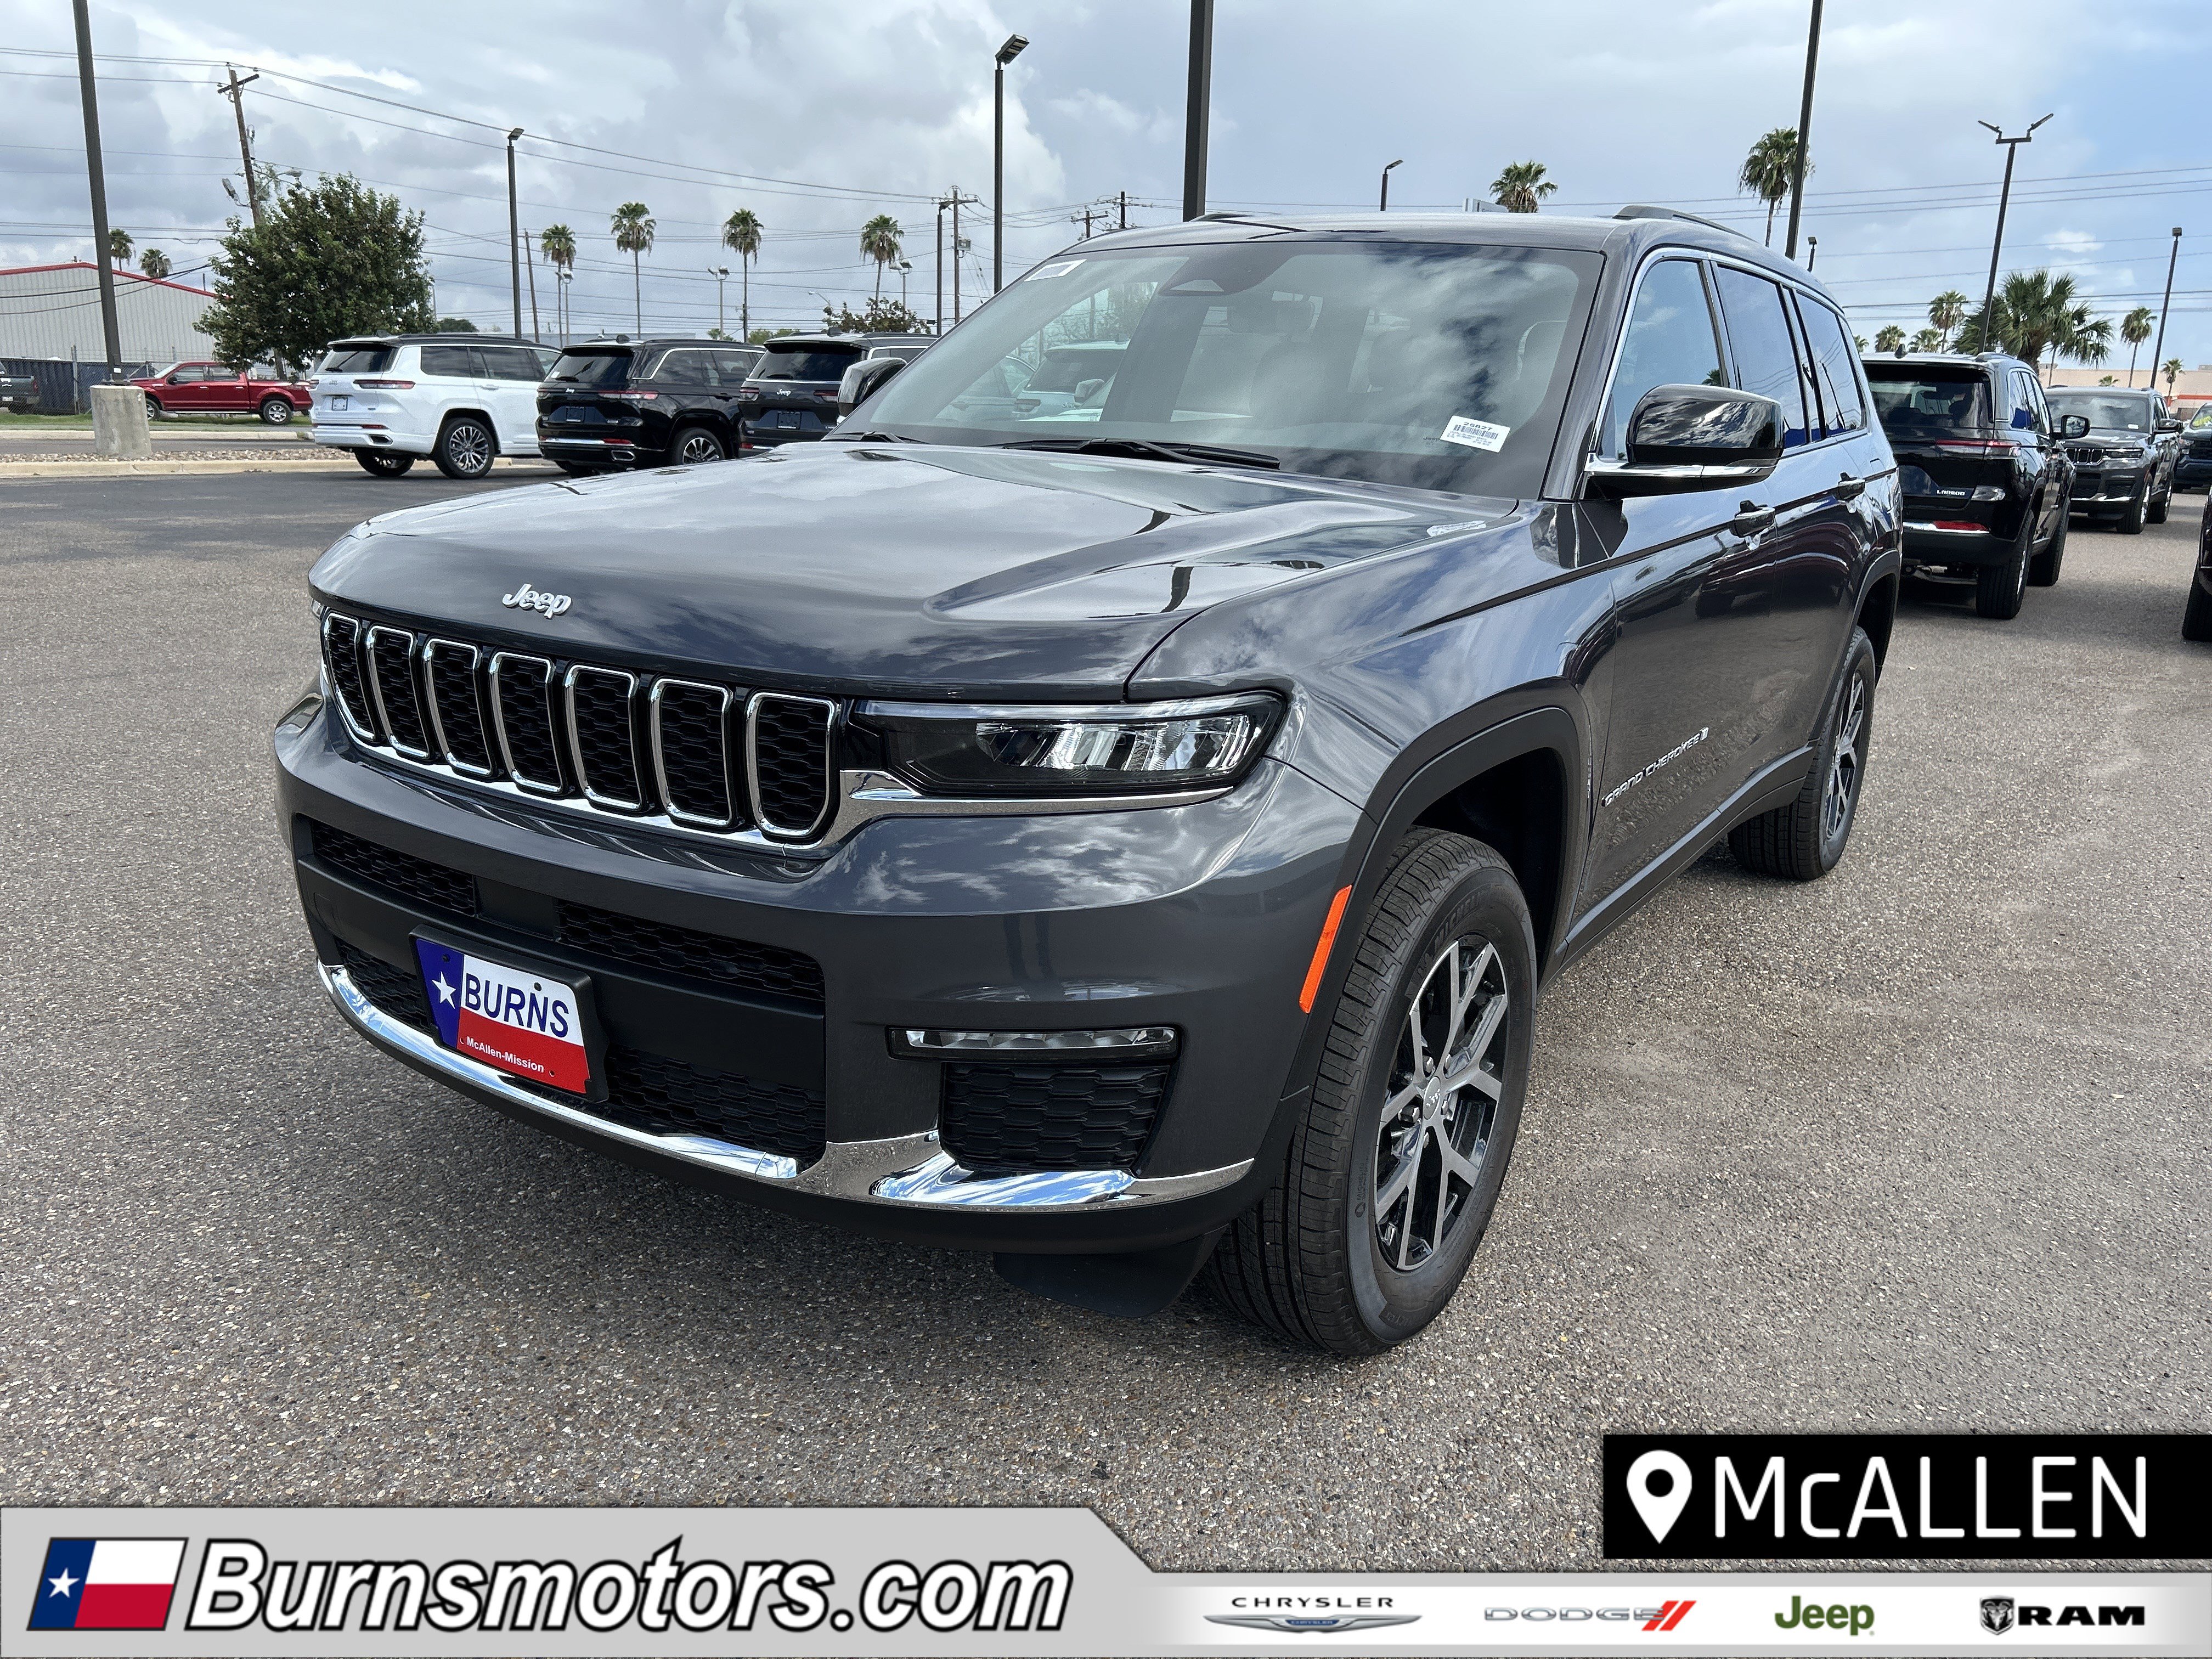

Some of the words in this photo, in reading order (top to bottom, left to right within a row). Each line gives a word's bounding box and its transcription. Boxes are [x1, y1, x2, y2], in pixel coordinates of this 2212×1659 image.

[502, 583, 572, 619] Jeep
[1601, 771, 1644, 808] GRAND
[1643, 732, 1700, 777] CHEROKEE
[465, 972, 569, 1038] BURNS
[466, 1036, 545, 1074] McAllen-Mission
